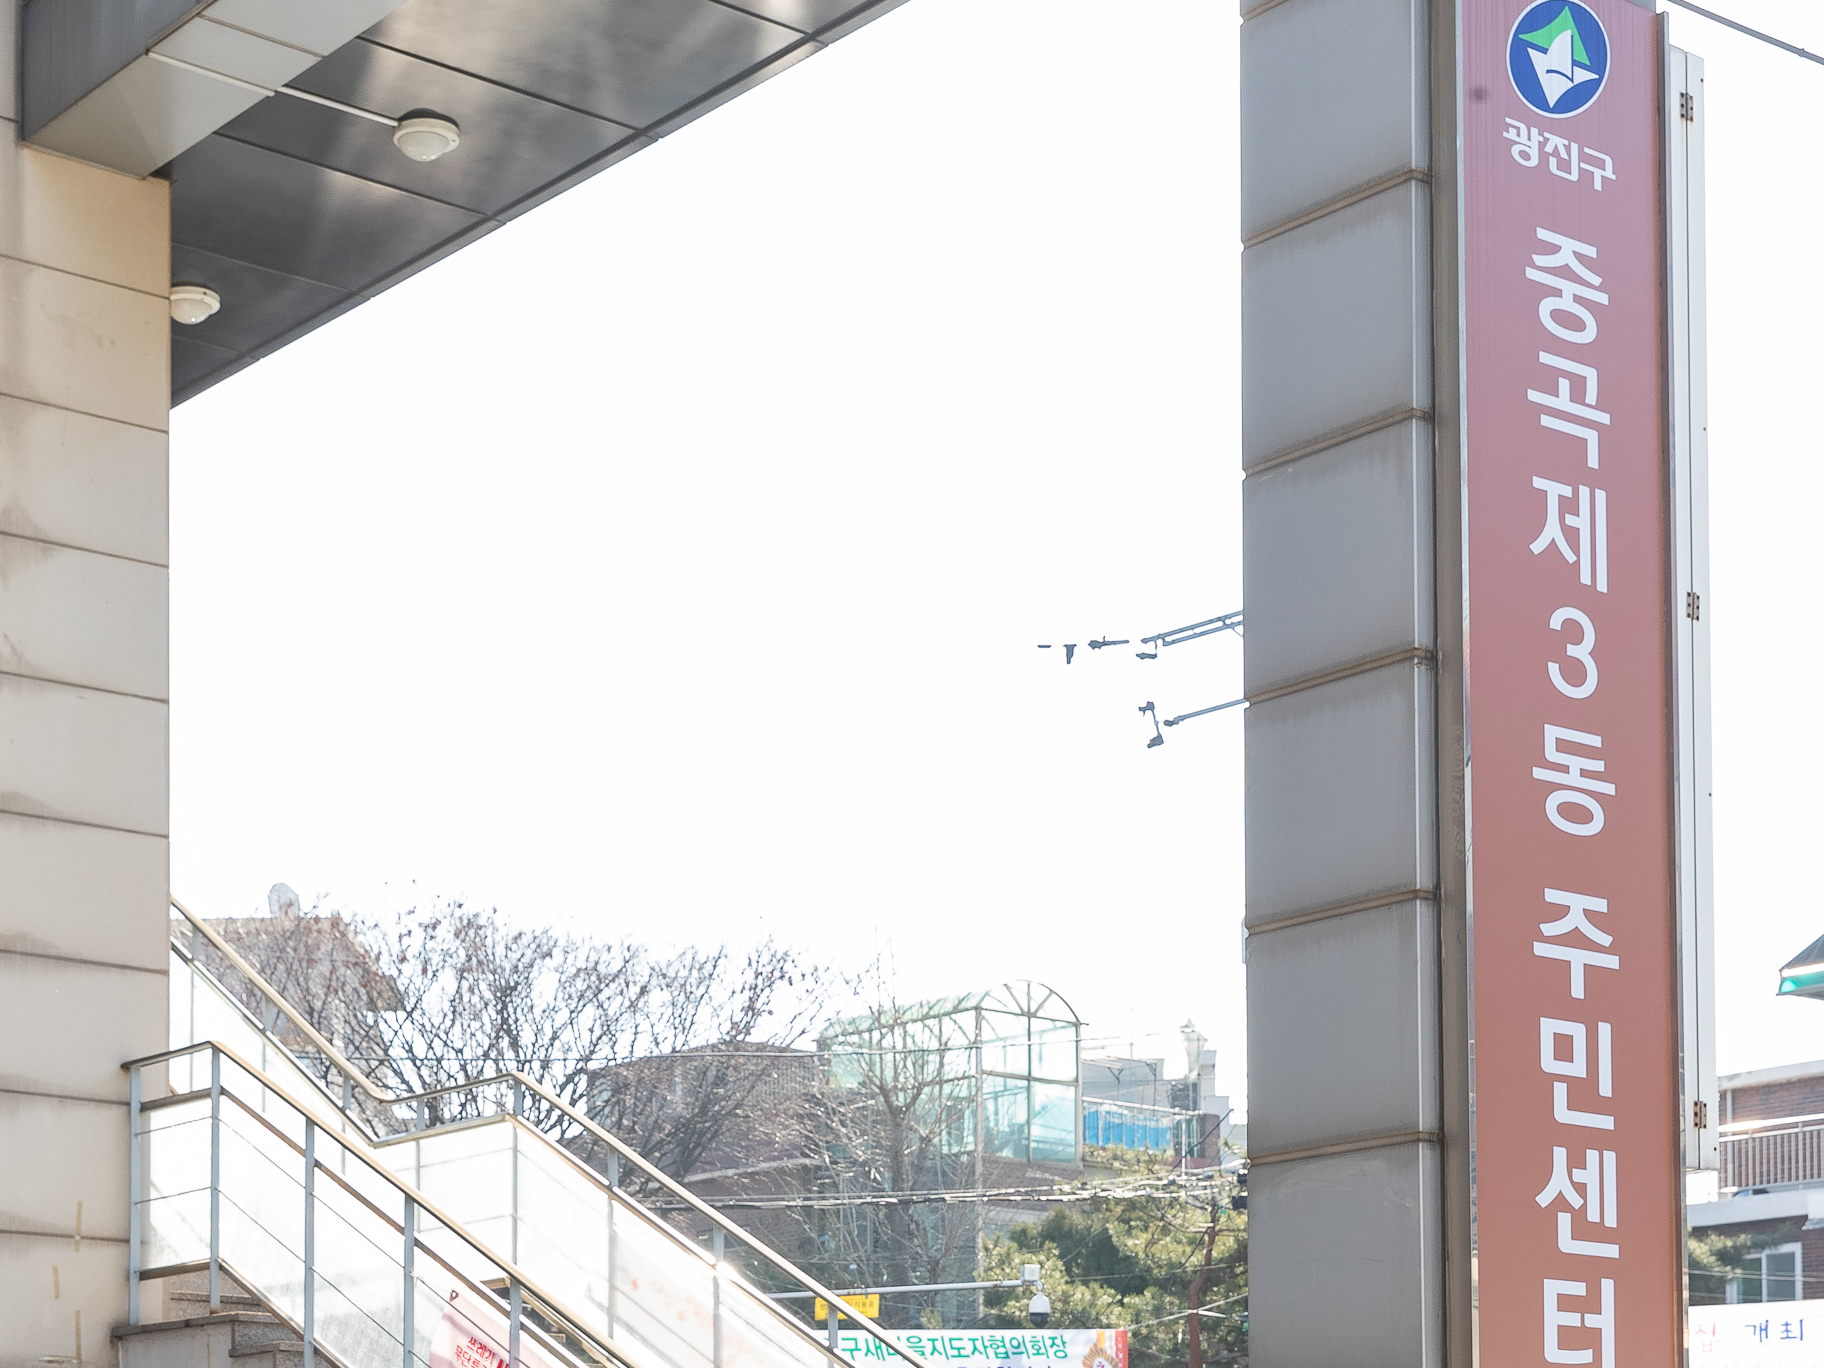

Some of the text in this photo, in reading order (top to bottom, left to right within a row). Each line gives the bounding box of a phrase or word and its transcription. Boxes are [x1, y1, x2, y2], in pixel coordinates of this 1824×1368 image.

[1503, 116, 1616, 191] 광진구
[1744, 1319, 1804, 1342] 개최
[466, 1336, 497, 1365] 쓰레기
